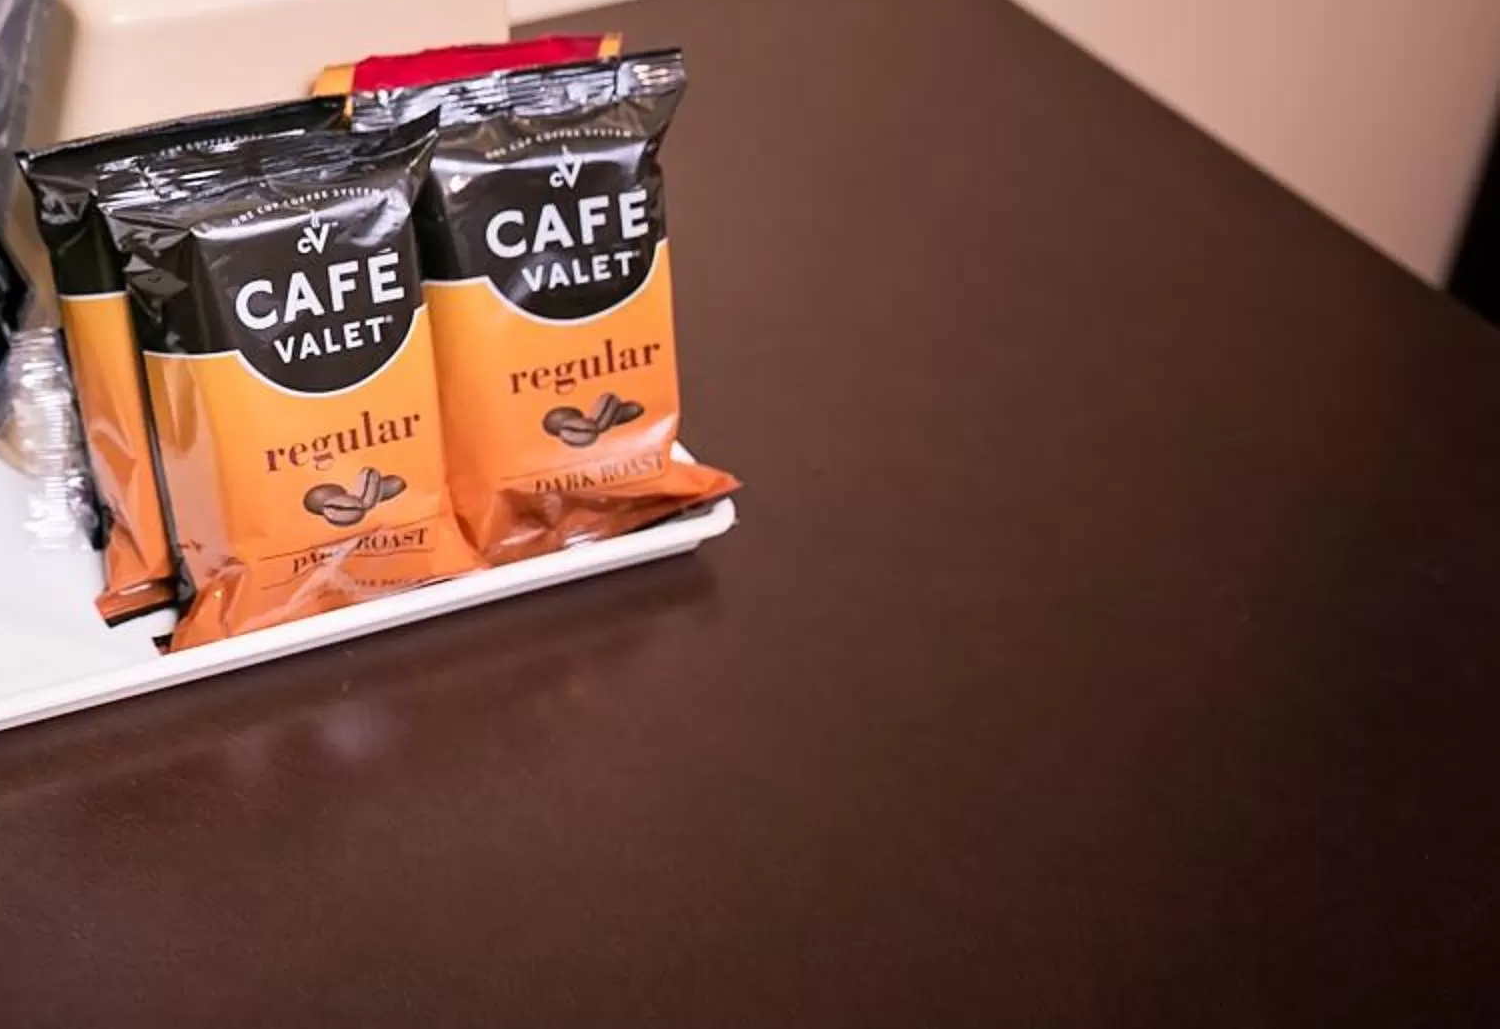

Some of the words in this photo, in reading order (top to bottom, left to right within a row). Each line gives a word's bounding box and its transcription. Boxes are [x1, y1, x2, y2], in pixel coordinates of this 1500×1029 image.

[235, 248, 405, 330] CAFÉ
[521, 250, 633, 292] VALET
[274, 316, 386, 364] VALET
[509, 338, 661, 395] regular
[264, 411, 421, 472] regular
